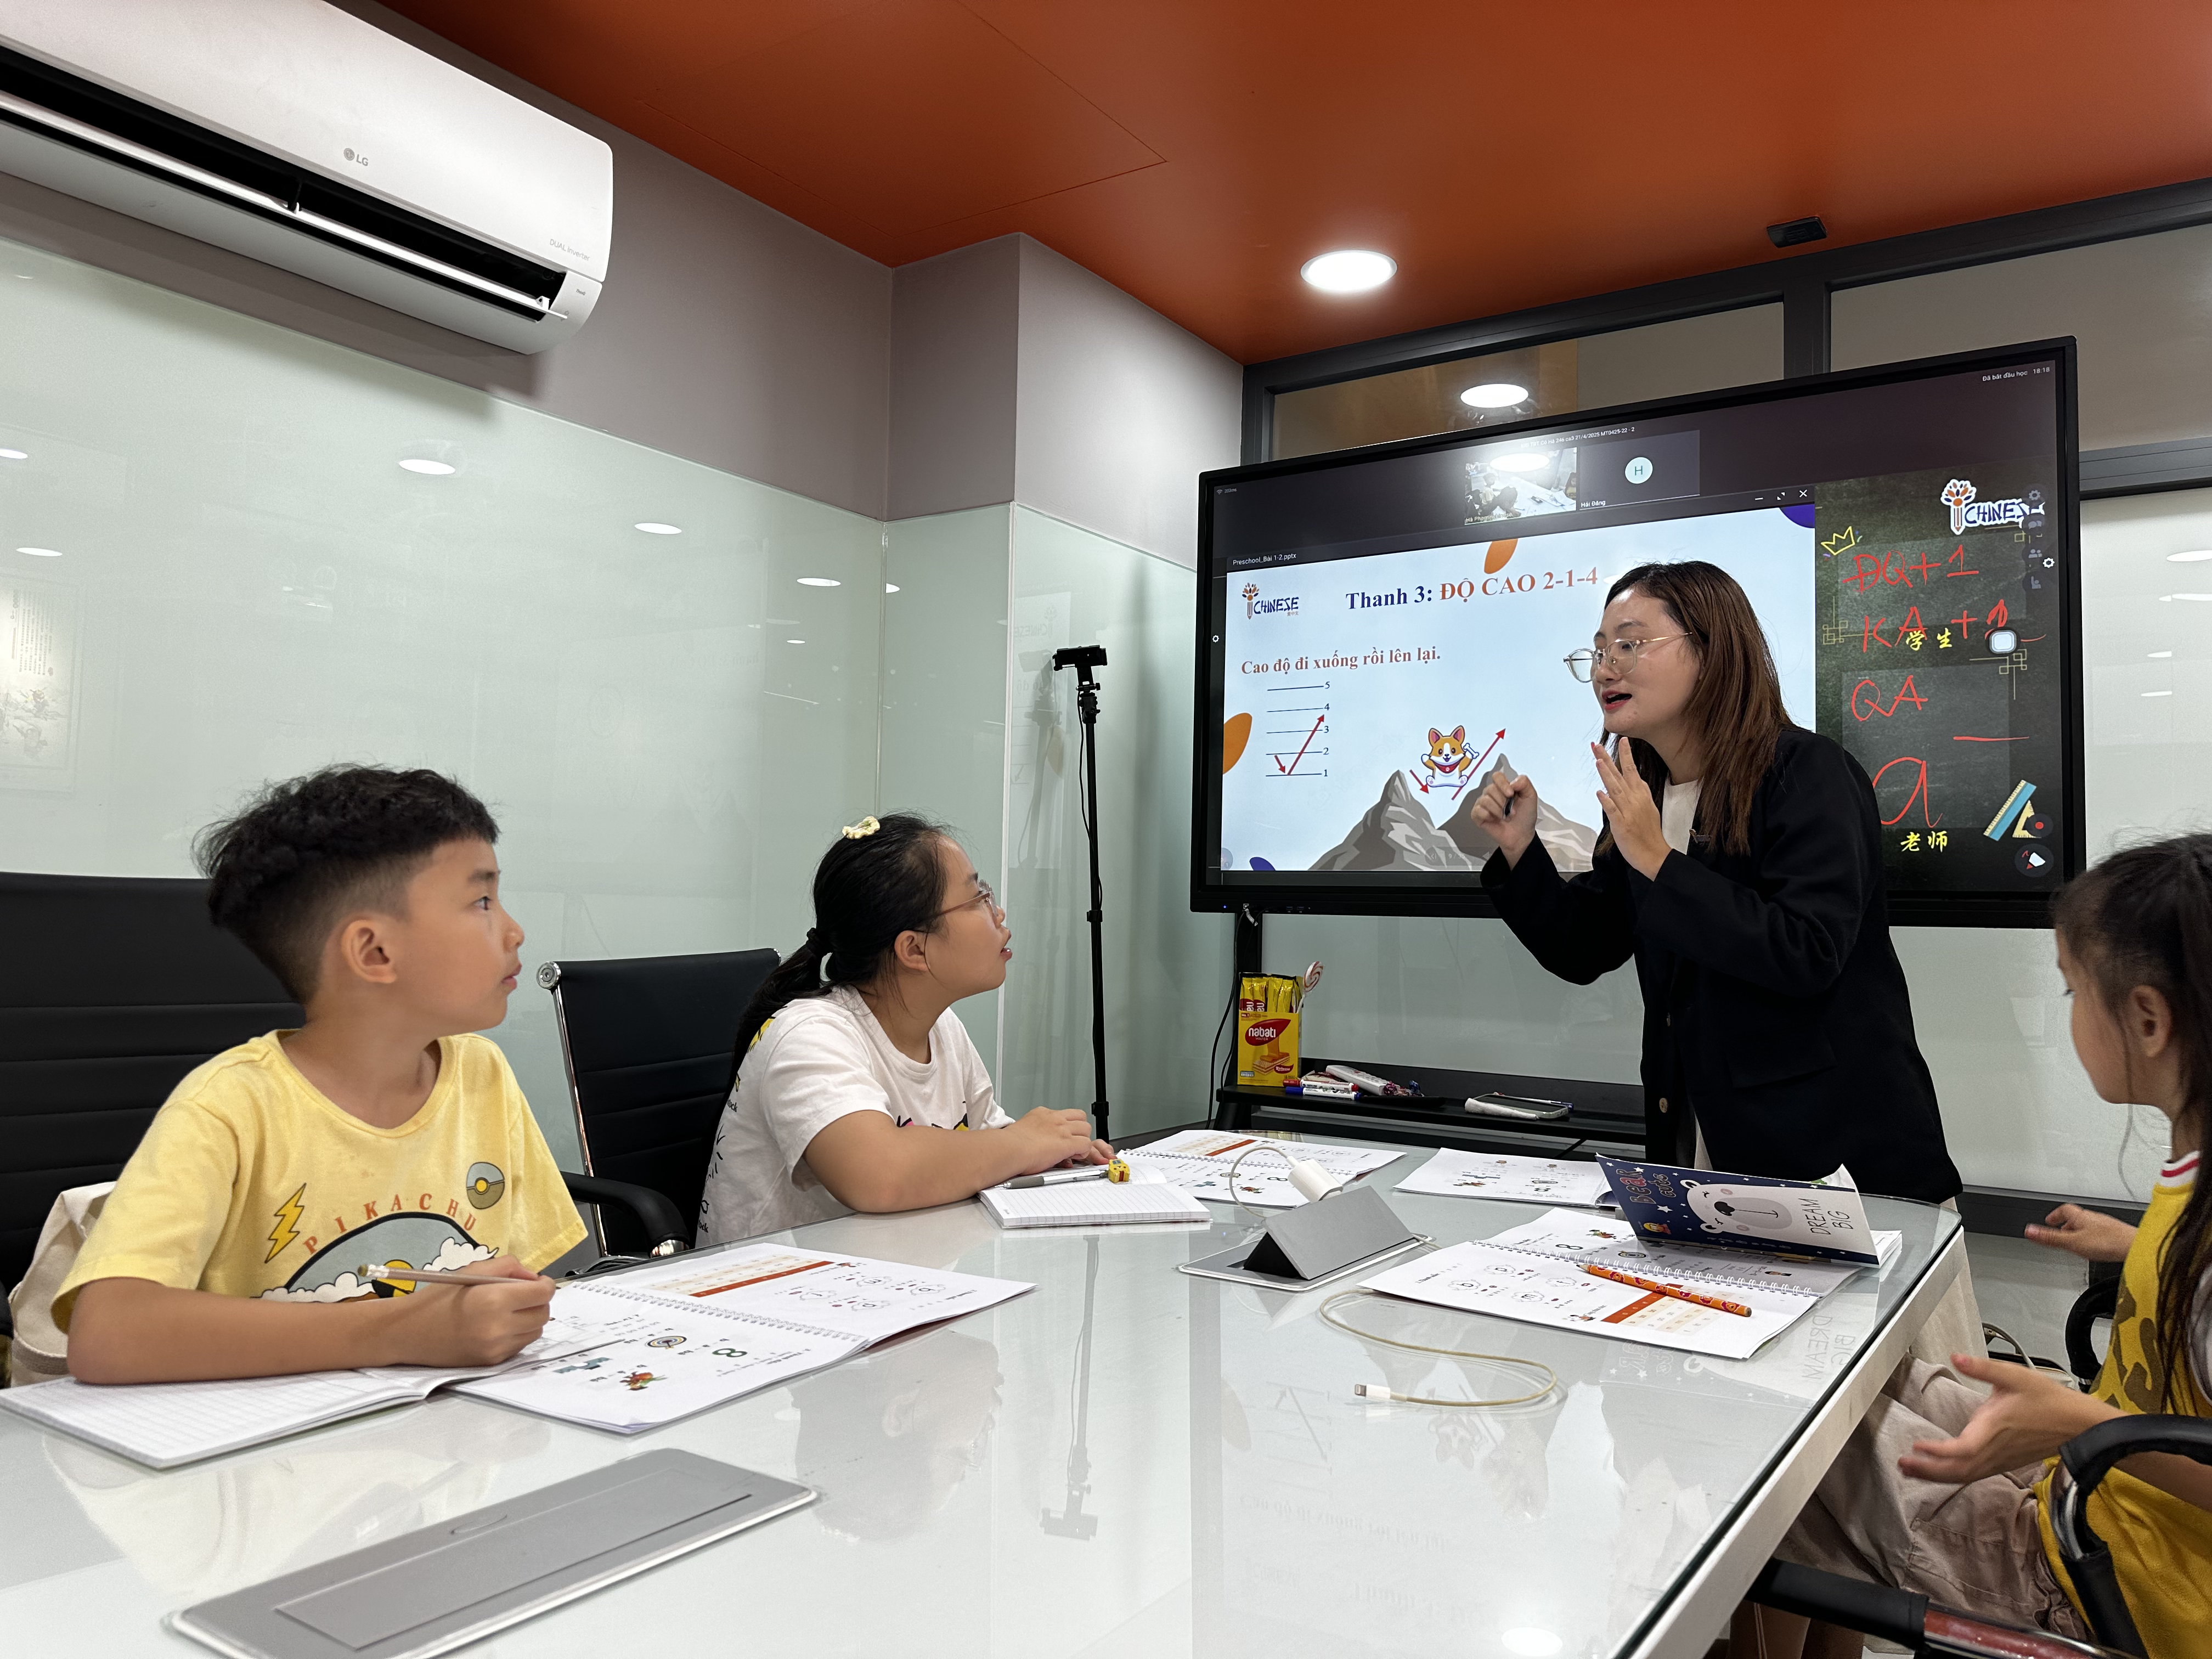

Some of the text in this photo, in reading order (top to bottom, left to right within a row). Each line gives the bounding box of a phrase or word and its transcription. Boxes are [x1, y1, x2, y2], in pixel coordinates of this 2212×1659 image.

[356, 154, 369, 166] LG
[549, 239, 590, 261] DUAL Inverter
[1575, 432, 1600, 441] 21/4/2025
[1634, 465, 1643, 476] H
[1345, 567, 1599, 610] Thanh 3: ĐỘ CAO 2-1-4
[1905, 627, 1953, 651] 学生
[1241, 646, 1441, 675] Cao độ đi xuống rồi lên lại.
[1324, 681, 1330, 690] 5
[1324, 703, 1330, 711] 4
[1323, 747, 1329, 755] 2
[1900, 831, 1948, 853] 老师
[1248, 1026, 1276, 1038] nabati
[303, 1192, 477, 1255] PIKACHU
[1798, 1198, 1831, 1235] DREAM
[1827, 1210, 1854, 1229] BIG
[712, 1347, 748, 1358] 8
